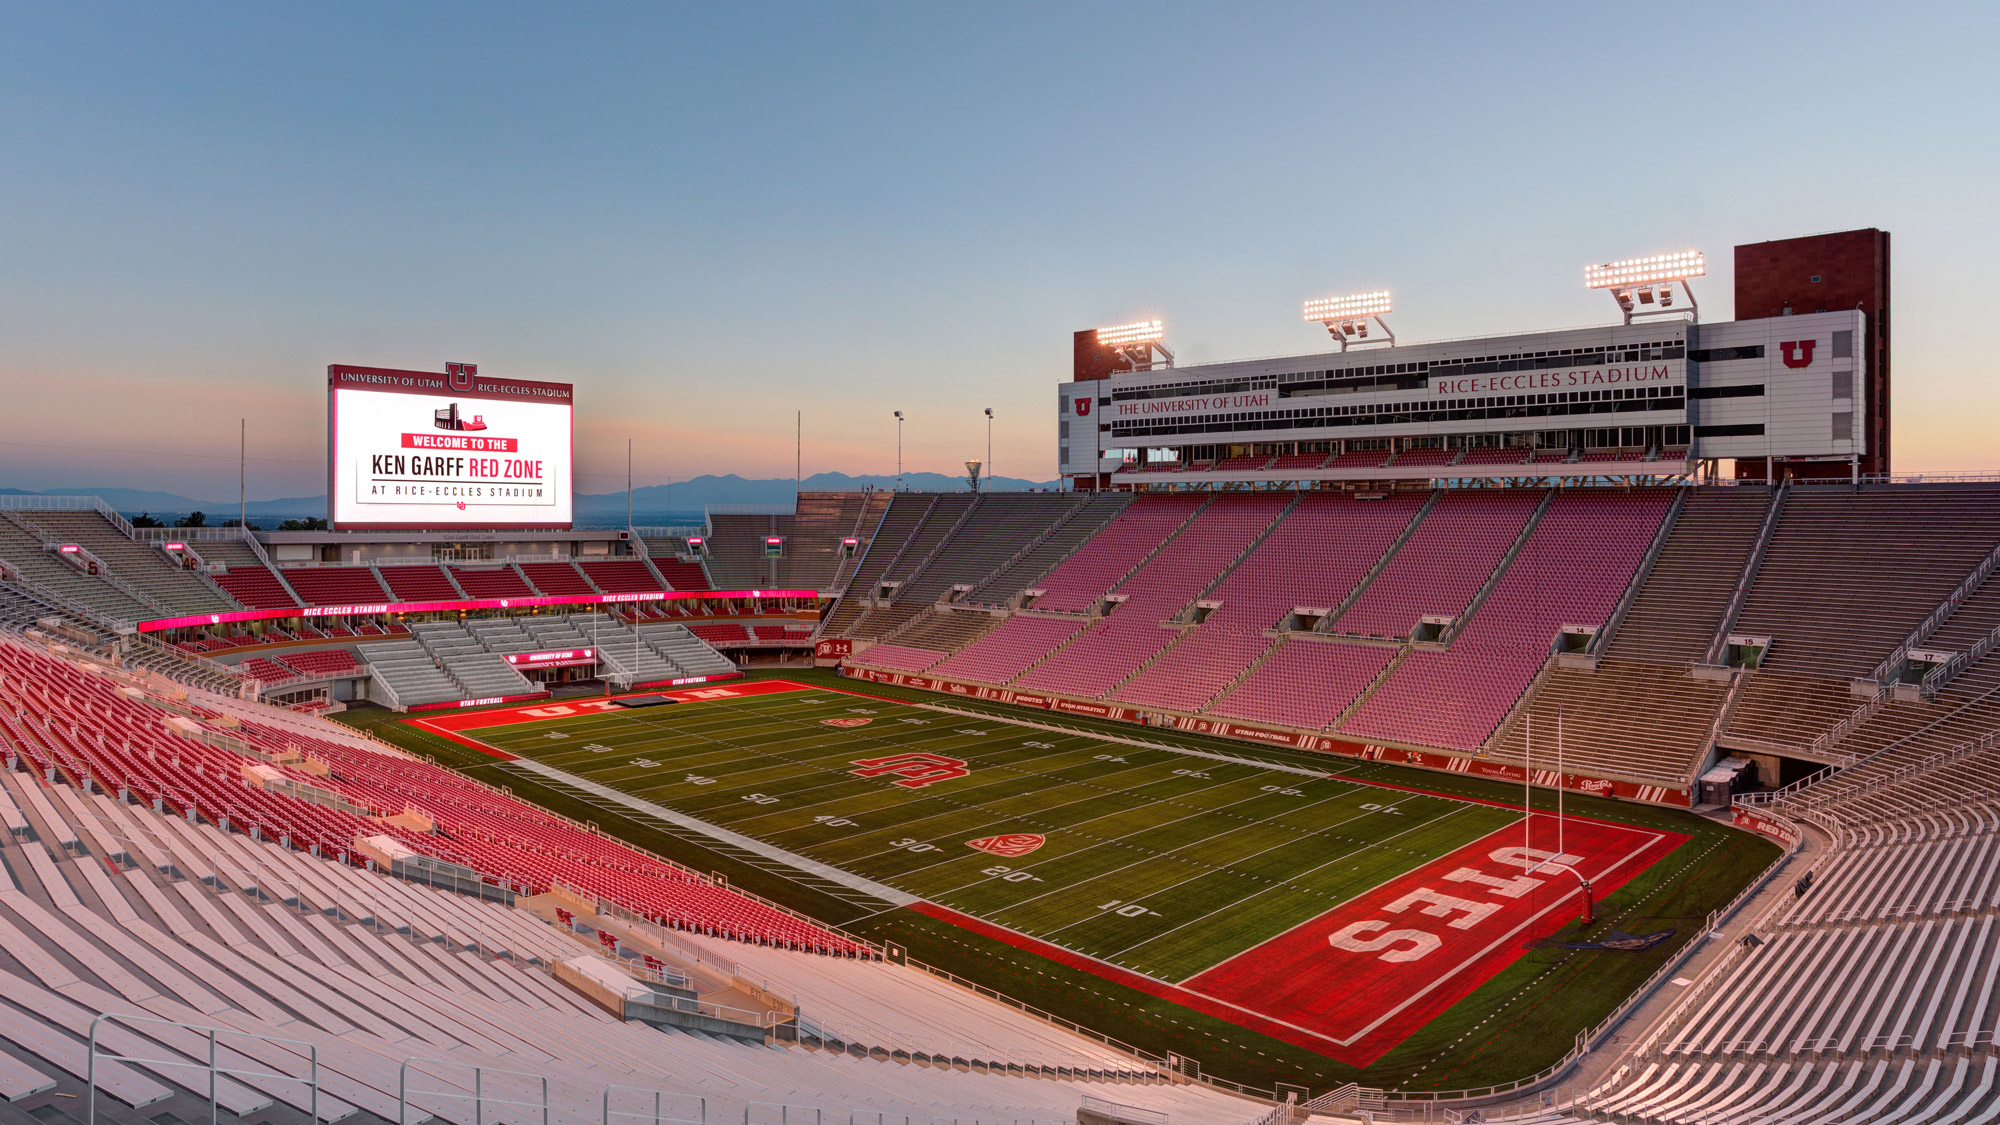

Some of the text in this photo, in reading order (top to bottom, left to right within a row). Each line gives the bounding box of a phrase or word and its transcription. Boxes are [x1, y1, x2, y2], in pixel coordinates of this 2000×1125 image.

[1779, 339, 1817, 369] U
[340, 372, 443, 389] UNIVERSITY OF UTAH
[445, 362, 477, 392] U
[1438, 364, 1670, 395] RICE-ECCLES STADIUM
[478, 383, 570, 398] RICE-ECCLES STADIUM
[1075, 397, 1092, 417] U
[1118, 393, 1269, 416] THE UNIVERSITY OF UTAH
[412, 435, 507, 450] WELCOME TO THE
[372, 454, 543, 479] KEN GARFF RED ZONE
[372, 485, 543, 498] AT RICE-ECCLES STADIUM
[617, 594, 638, 602] ECCLES
[303, 605, 387, 616] RICE ECCLES STADIUM
[1924, 653, 1934, 661] 17
[476, 697, 504, 706] FOOTBALL
[1076, 704, 1106, 714] ATHLETICS
[1235, 728, 1290, 742] UTAH FOOTBALL
[741, 792, 781, 805] 50
[813, 815, 853, 827] 40
[1757, 821, 1779, 836] RED
[889, 837, 936, 853] 30
[980, 865, 1034, 883] 20
[1097, 900, 1149, 918] 10
[1328, 846, 1585, 963] UTES
